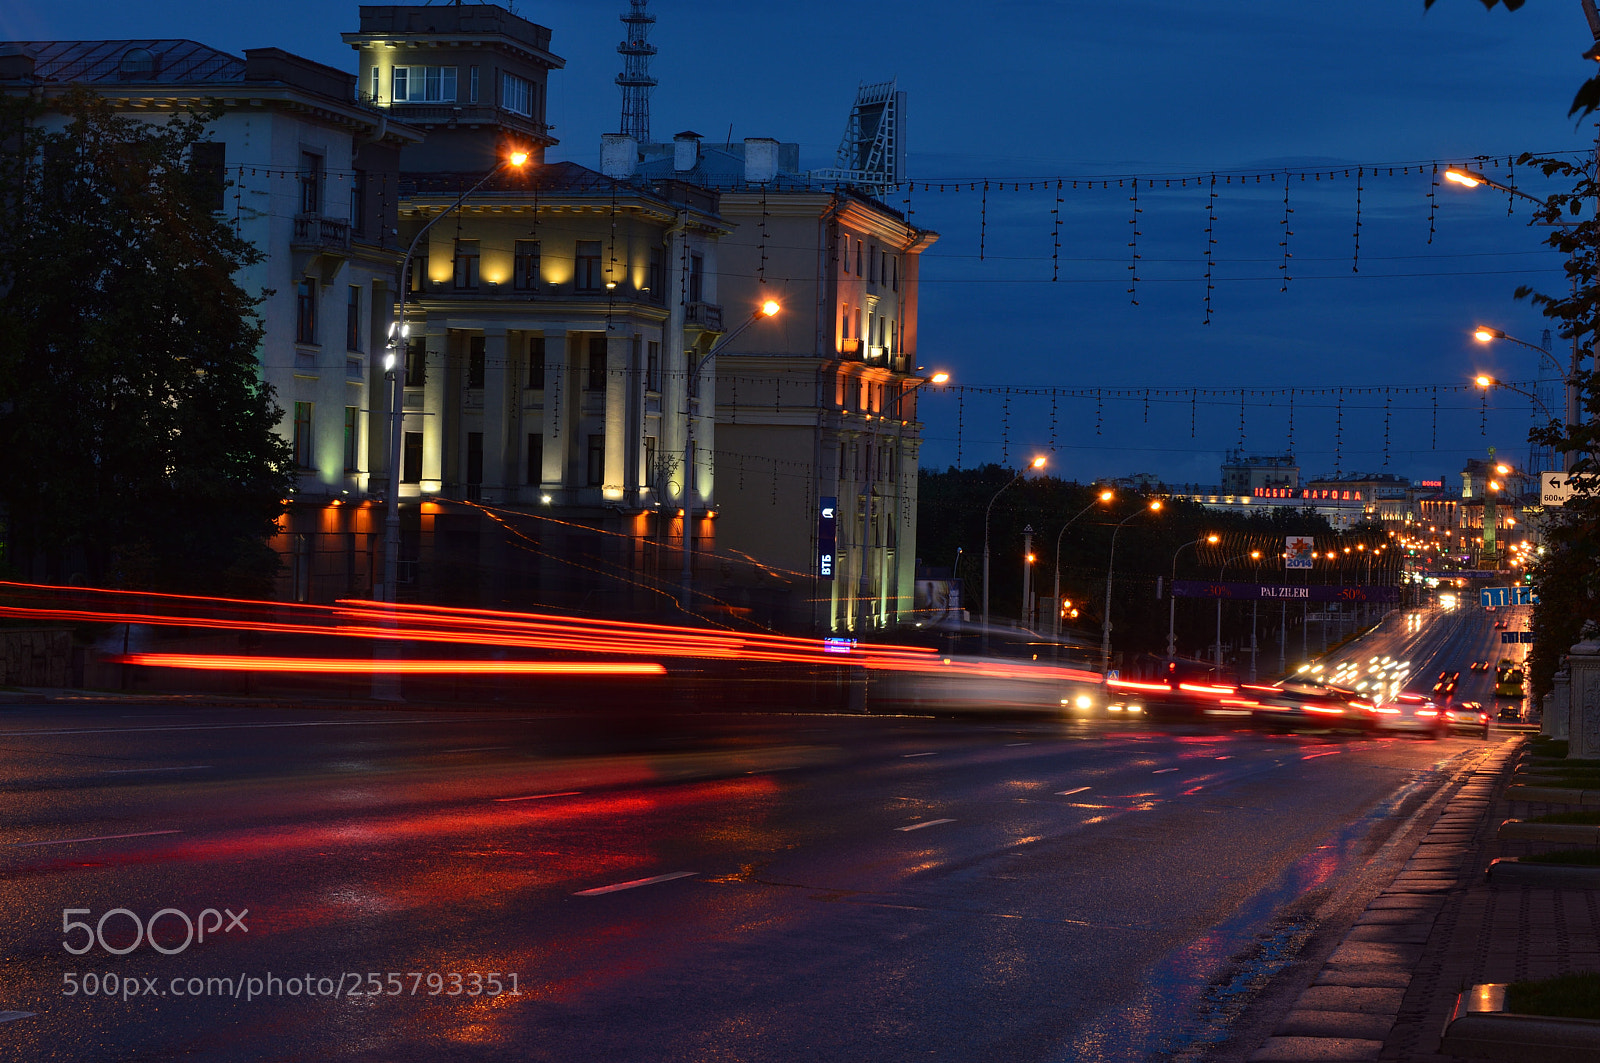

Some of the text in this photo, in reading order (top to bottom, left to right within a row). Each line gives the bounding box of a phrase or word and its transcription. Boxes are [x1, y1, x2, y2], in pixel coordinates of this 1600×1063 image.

[1303, 489, 1361, 500] НАРОДА
[1287, 559, 1312, 568] 2014
[1261, 587, 1277, 597] PAL
[1279, 587, 1309, 598] ZILERI
[1336, 588, 1367, 601] -50%
